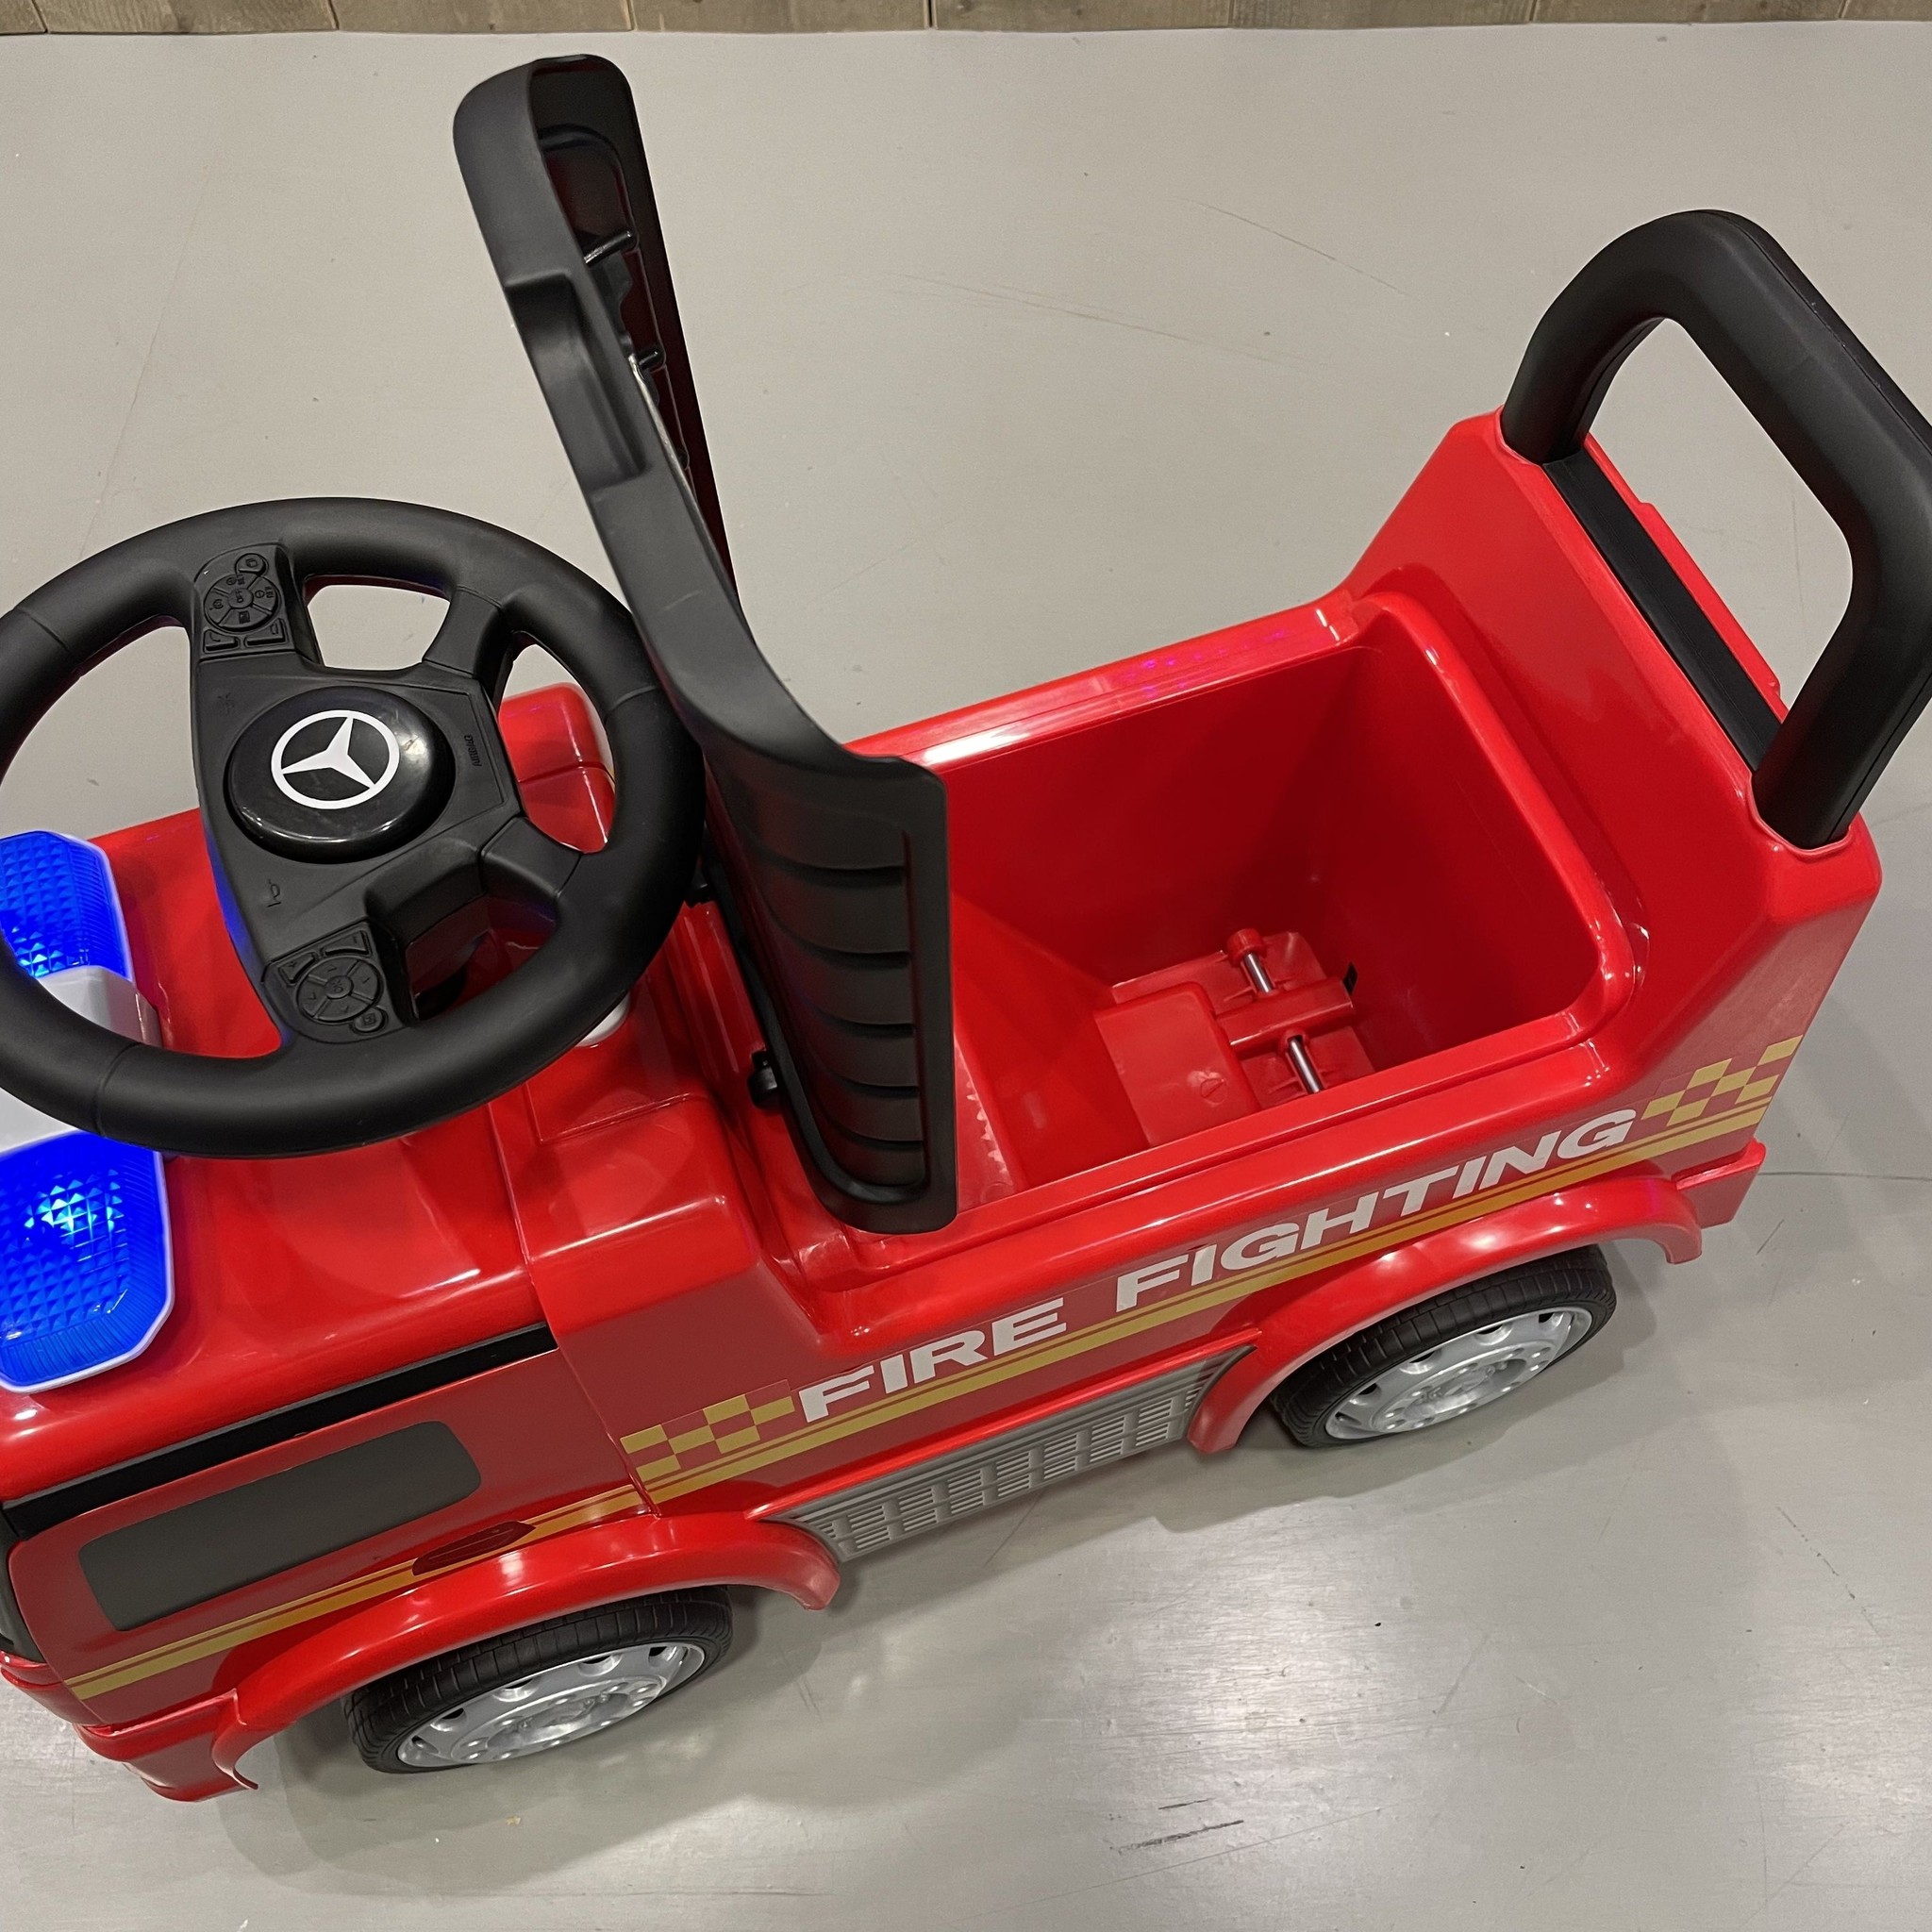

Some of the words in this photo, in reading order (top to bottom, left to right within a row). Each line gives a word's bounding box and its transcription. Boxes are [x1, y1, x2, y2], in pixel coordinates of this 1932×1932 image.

[463, 734, 483, 767] AIRBAG
[798, 1297, 1068, 1424] FIRE
[1115, 1108, 1638, 1312] FIGHTING
